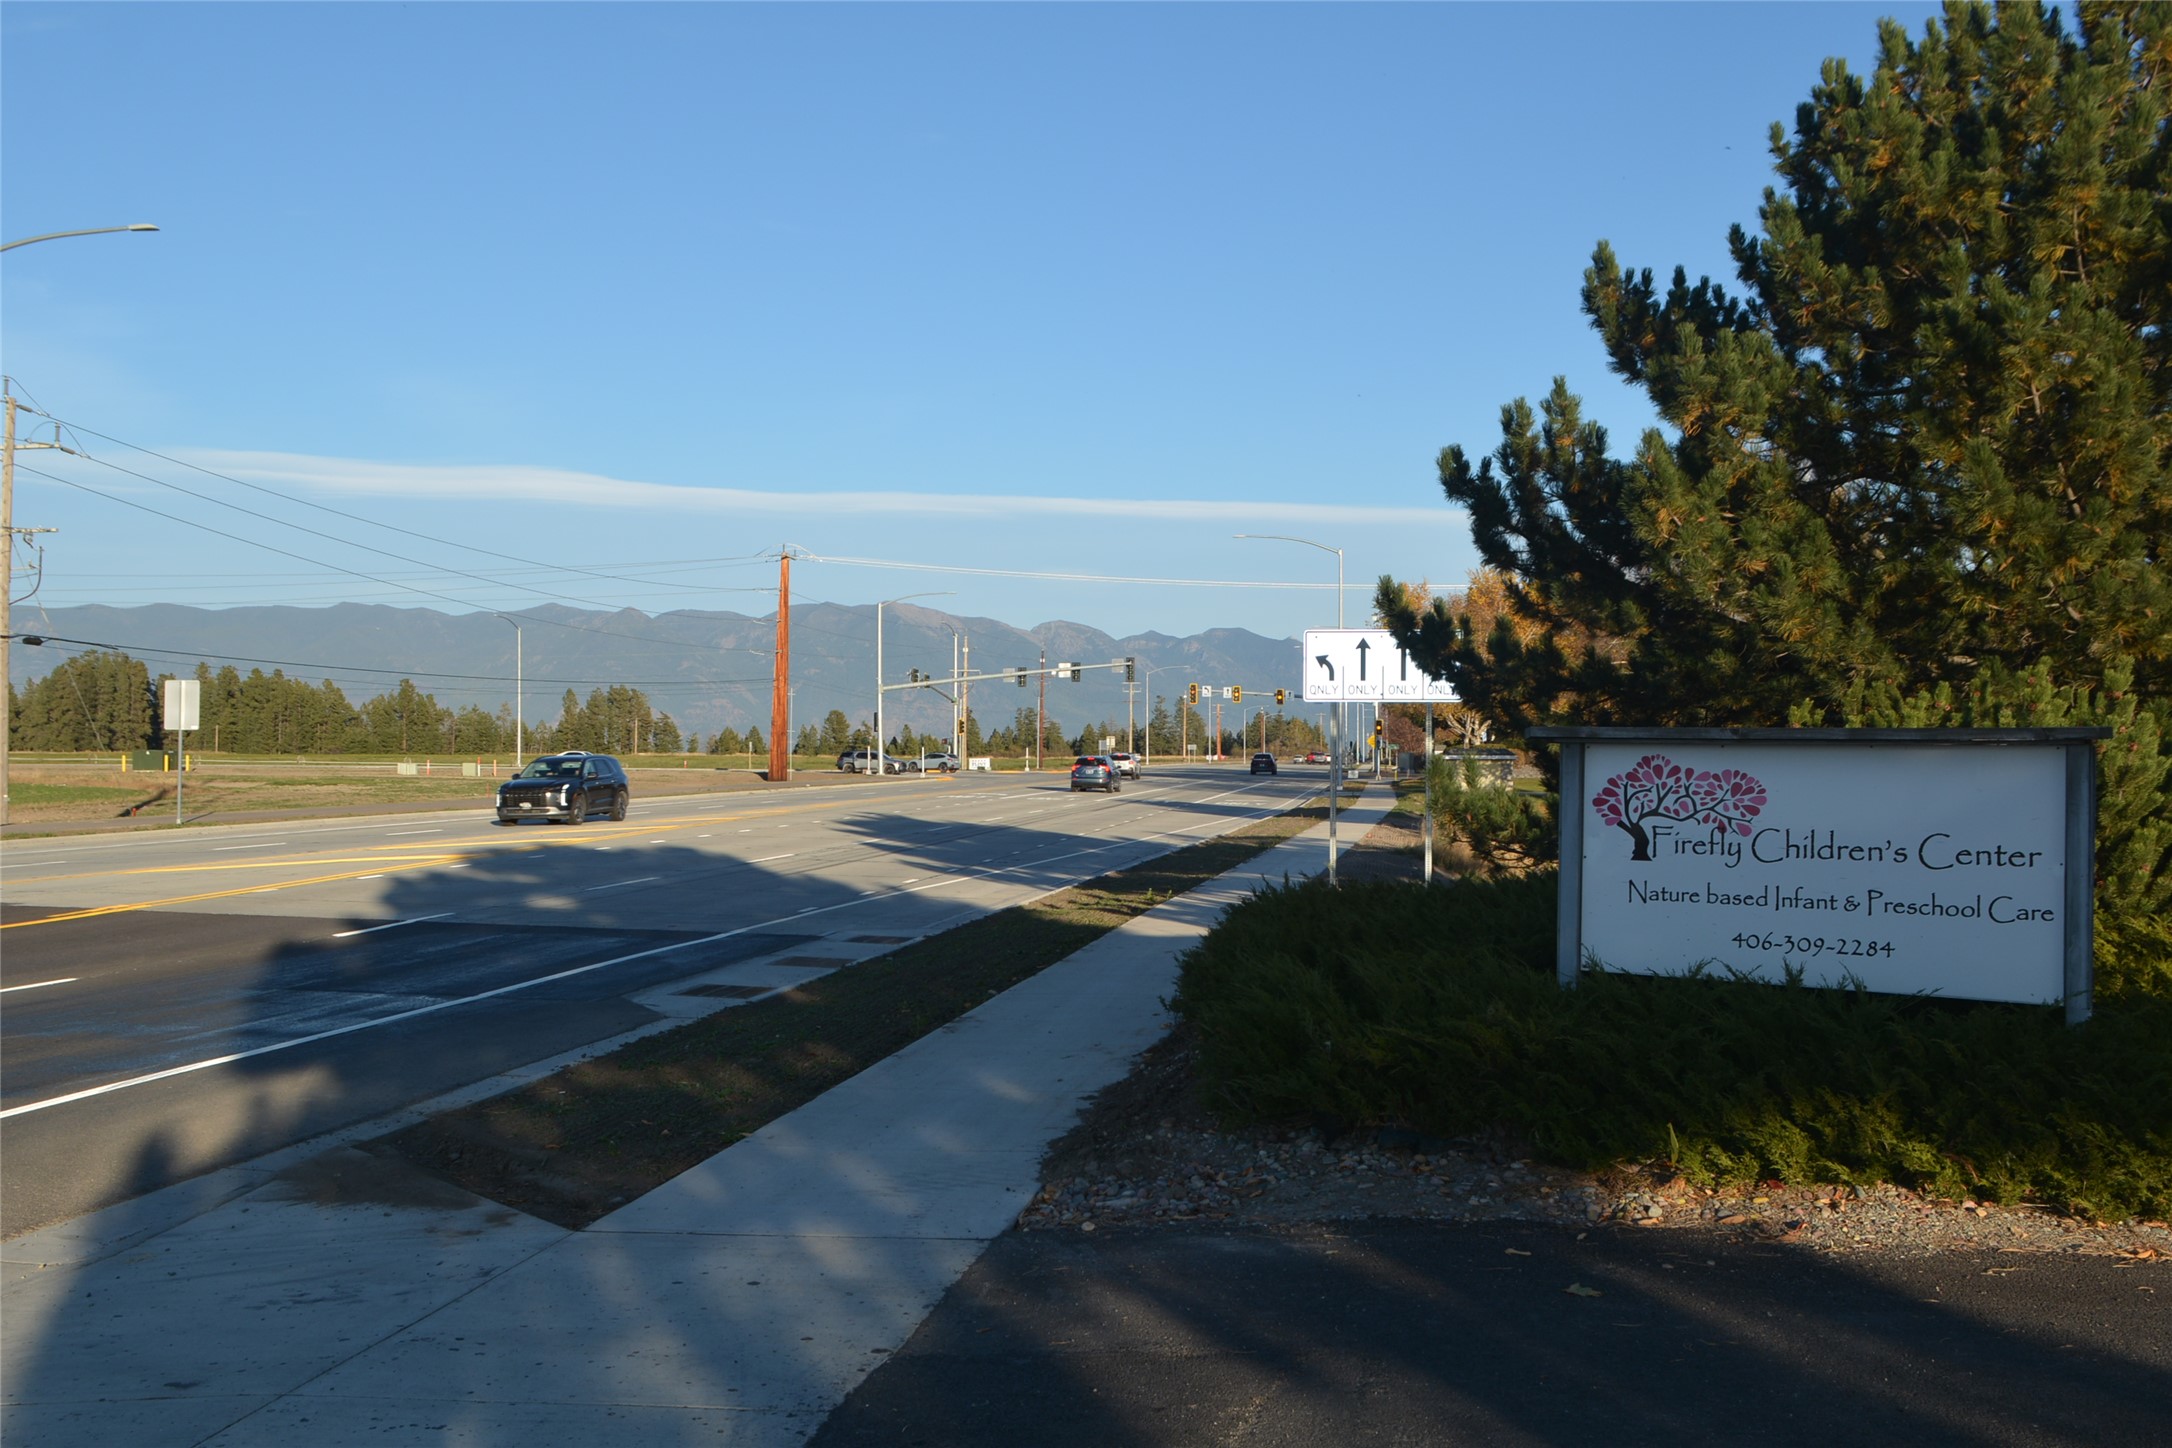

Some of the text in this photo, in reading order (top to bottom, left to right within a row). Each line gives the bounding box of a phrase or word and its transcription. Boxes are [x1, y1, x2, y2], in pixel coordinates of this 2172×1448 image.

[1309, 684, 1453, 695] ONLY ONLY ONLY ONL
[1652, 826, 2042, 870] Firefly Children's Center
[1628, 879, 2055, 923] Nature based Infant & Preschool Care
[1732, 932, 1895, 958] 406-309-2284
